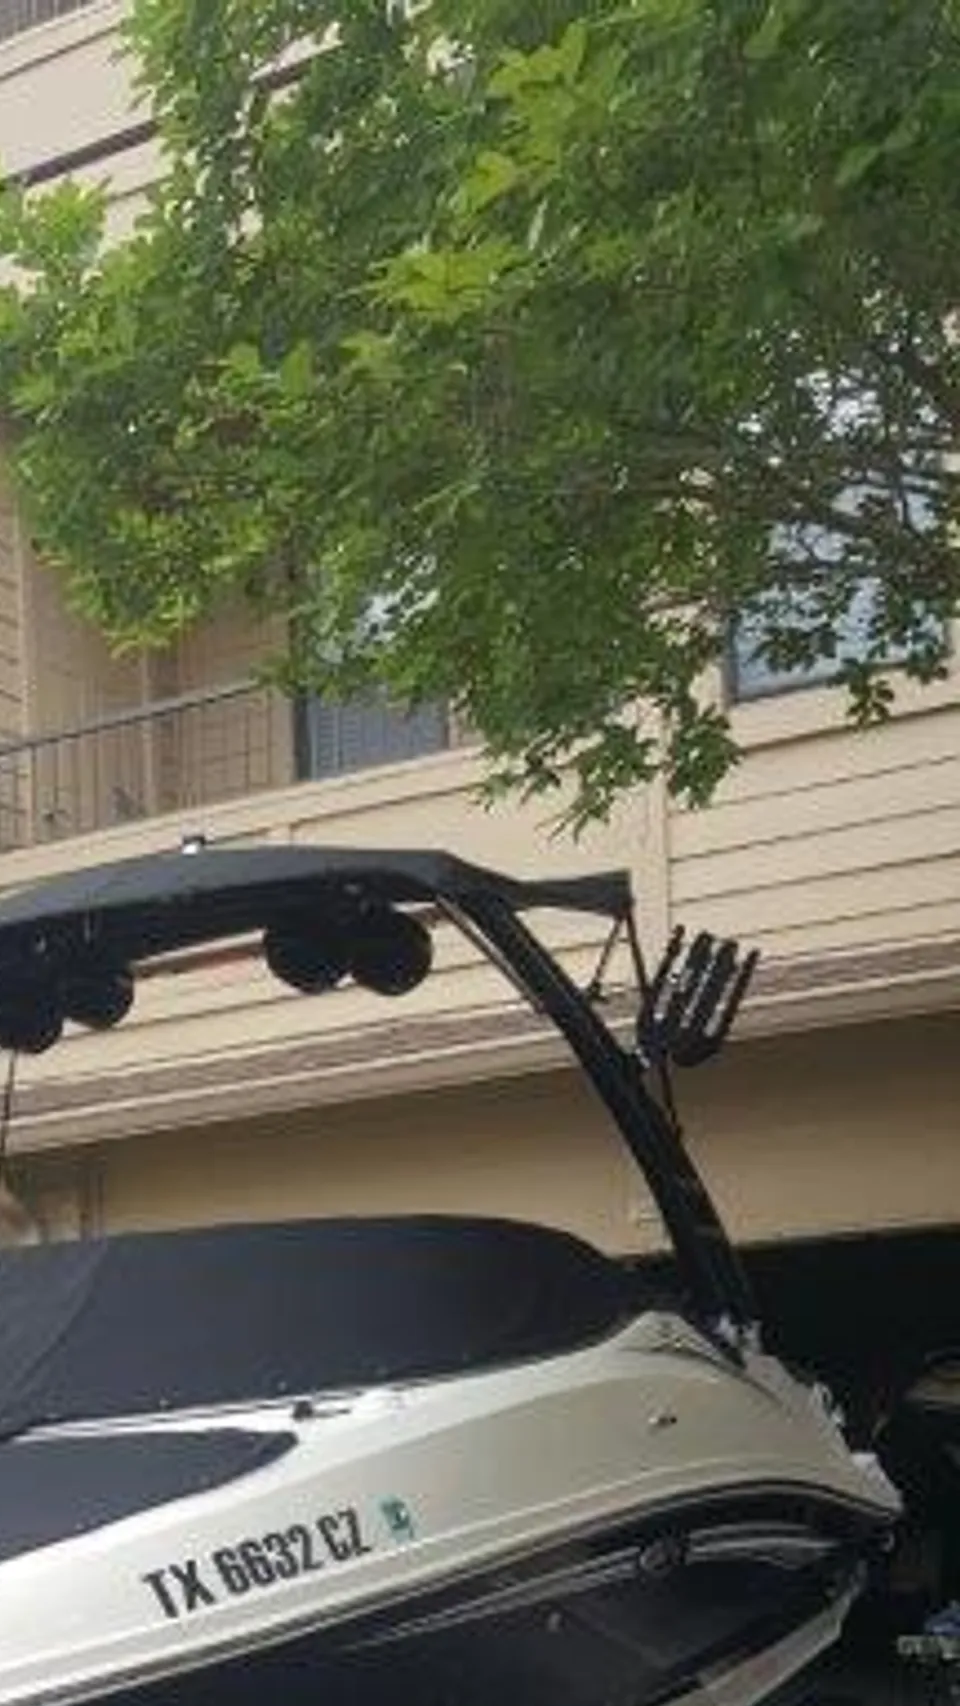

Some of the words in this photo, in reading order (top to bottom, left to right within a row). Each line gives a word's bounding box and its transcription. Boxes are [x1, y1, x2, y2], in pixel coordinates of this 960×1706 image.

[142, 1559, 216, 1618] TX
[212, 1524, 323, 1596] 6632
[315, 1507, 372, 1562] CZ
